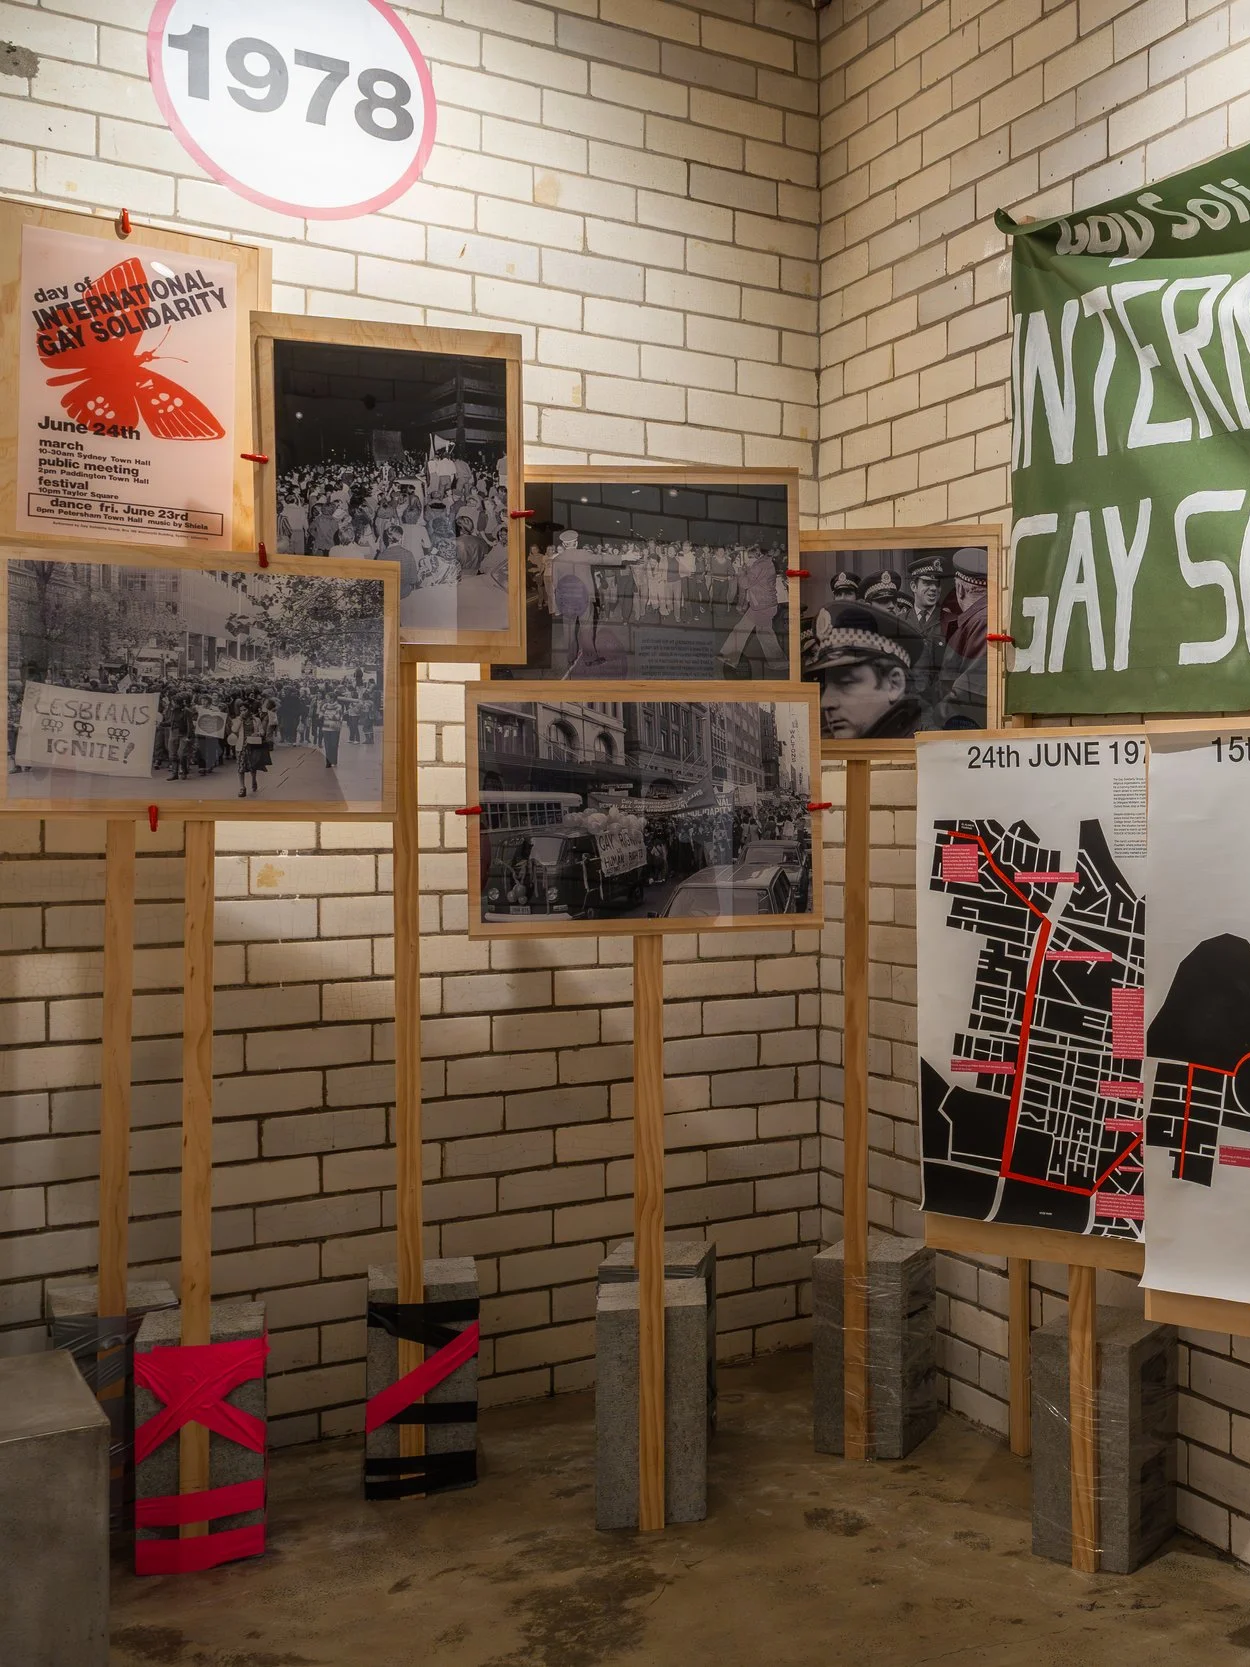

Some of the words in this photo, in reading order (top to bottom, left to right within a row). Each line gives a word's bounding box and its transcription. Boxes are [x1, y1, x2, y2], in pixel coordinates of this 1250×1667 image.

[168, 24, 415, 142] 1978
[1056, 210, 1155, 267] Gay
[32, 270, 214, 331] INTERNATIONAL
[33, 283, 69, 303] day
[74, 276, 93, 294] of
[37, 325, 86, 357] GAY
[90, 287, 227, 343] SOLIDARITY
[38, 416, 88, 434] June
[93, 422, 140, 440] 24th
[38, 448, 74, 457] 10-30am
[77, 452, 107, 462] Sydney
[111, 456, 132, 464] Town
[39, 439, 83, 451] march
[38, 467, 56, 475] 2pm
[60, 469, 106, 480] Paddington
[39, 457, 80, 469] public
[84, 463, 139, 477] meeting
[38, 476, 89, 490] festival
[38, 487, 61, 496] 10pm
[62, 489, 87, 498] Taylor
[91, 491, 119, 500] Square
[36, 506, 54, 515] 8pm
[58, 509, 101, 519] Petersham
[104, 513, 125, 522] Town
[128, 515, 143, 523] Hall
[147, 518, 170, 527] music
[173, 520, 182, 529] by
[50, 498, 92, 511] dance
[100, 502, 119, 514] fri.
[123, 505, 155, 517] June
[158, 510, 188, 521] 23rd
[1007, 498, 1152, 674] GAY
[34, 698, 150, 726] LESBIANS
[47, 738, 135, 764] IGNITE!
[967, 745, 1020, 769] 24th
[1028, 741, 1100, 768] JUNE
